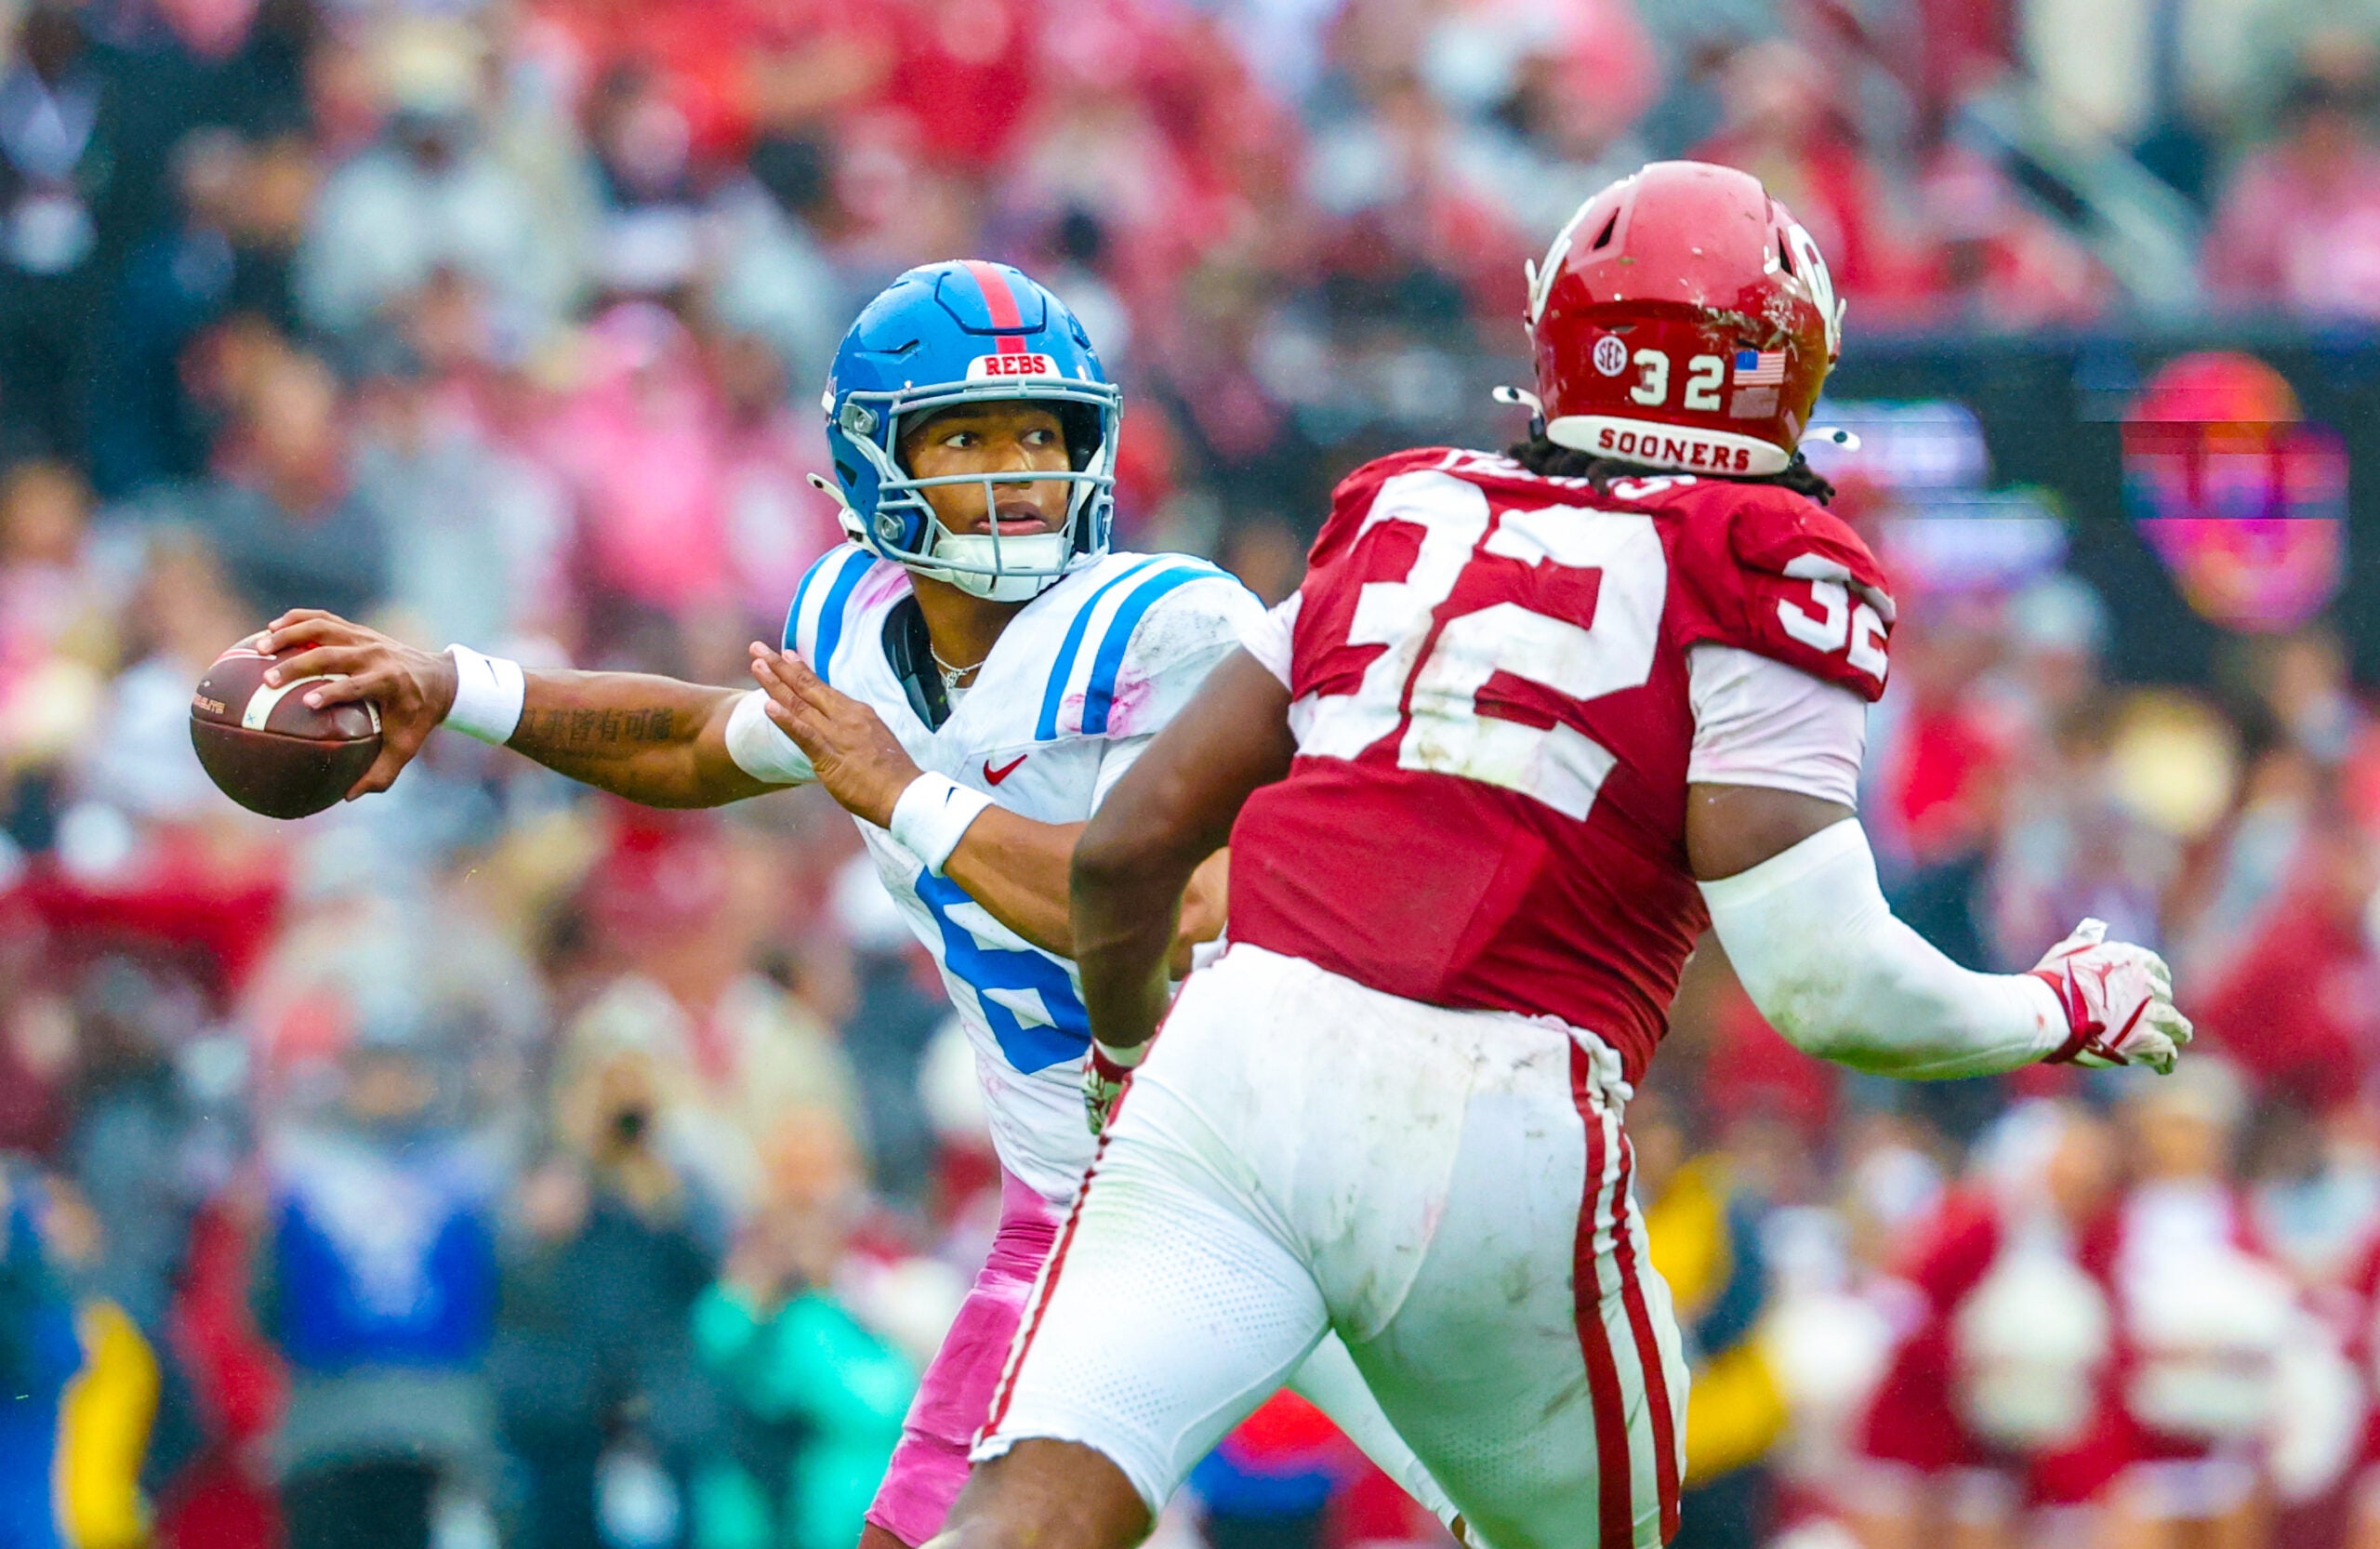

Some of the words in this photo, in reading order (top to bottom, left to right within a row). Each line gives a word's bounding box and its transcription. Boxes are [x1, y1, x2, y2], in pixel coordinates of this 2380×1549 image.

[985, 355, 1046, 376] REBS
[1598, 341, 1622, 373] SEC
[1630, 349, 1725, 411] 32
[1598, 429, 1751, 471] SOONERS
[1289, 470, 1668, 822] 32
[1777, 552, 1897, 683] 32
[914, 865, 1092, 1076] 6
